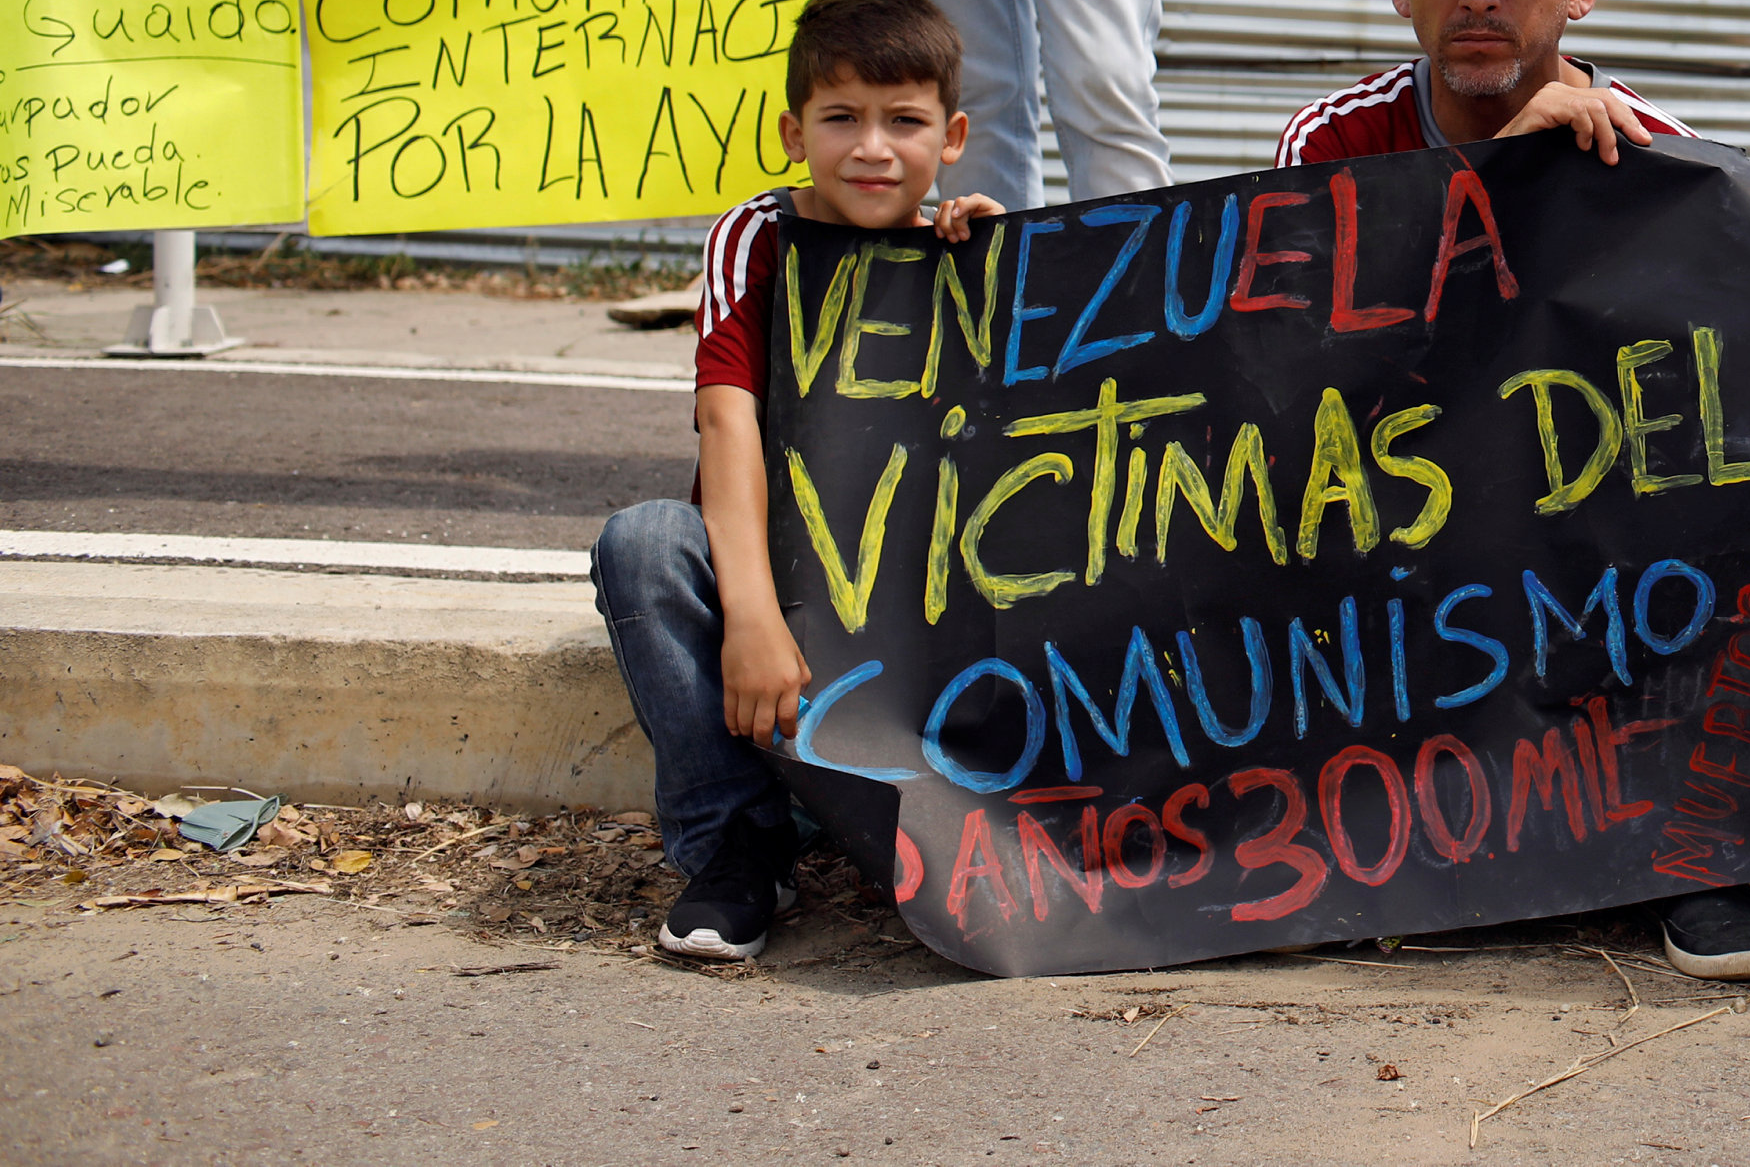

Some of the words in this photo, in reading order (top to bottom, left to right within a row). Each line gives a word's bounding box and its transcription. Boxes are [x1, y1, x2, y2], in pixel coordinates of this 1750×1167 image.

[333, 96, 501, 203] POR
[538, 95, 609, 200] LA
[784, 167, 1521, 400] VENEZUELA
[946, 781, 1215, 934] AÑOS
[1226, 732, 1494, 923] 300
